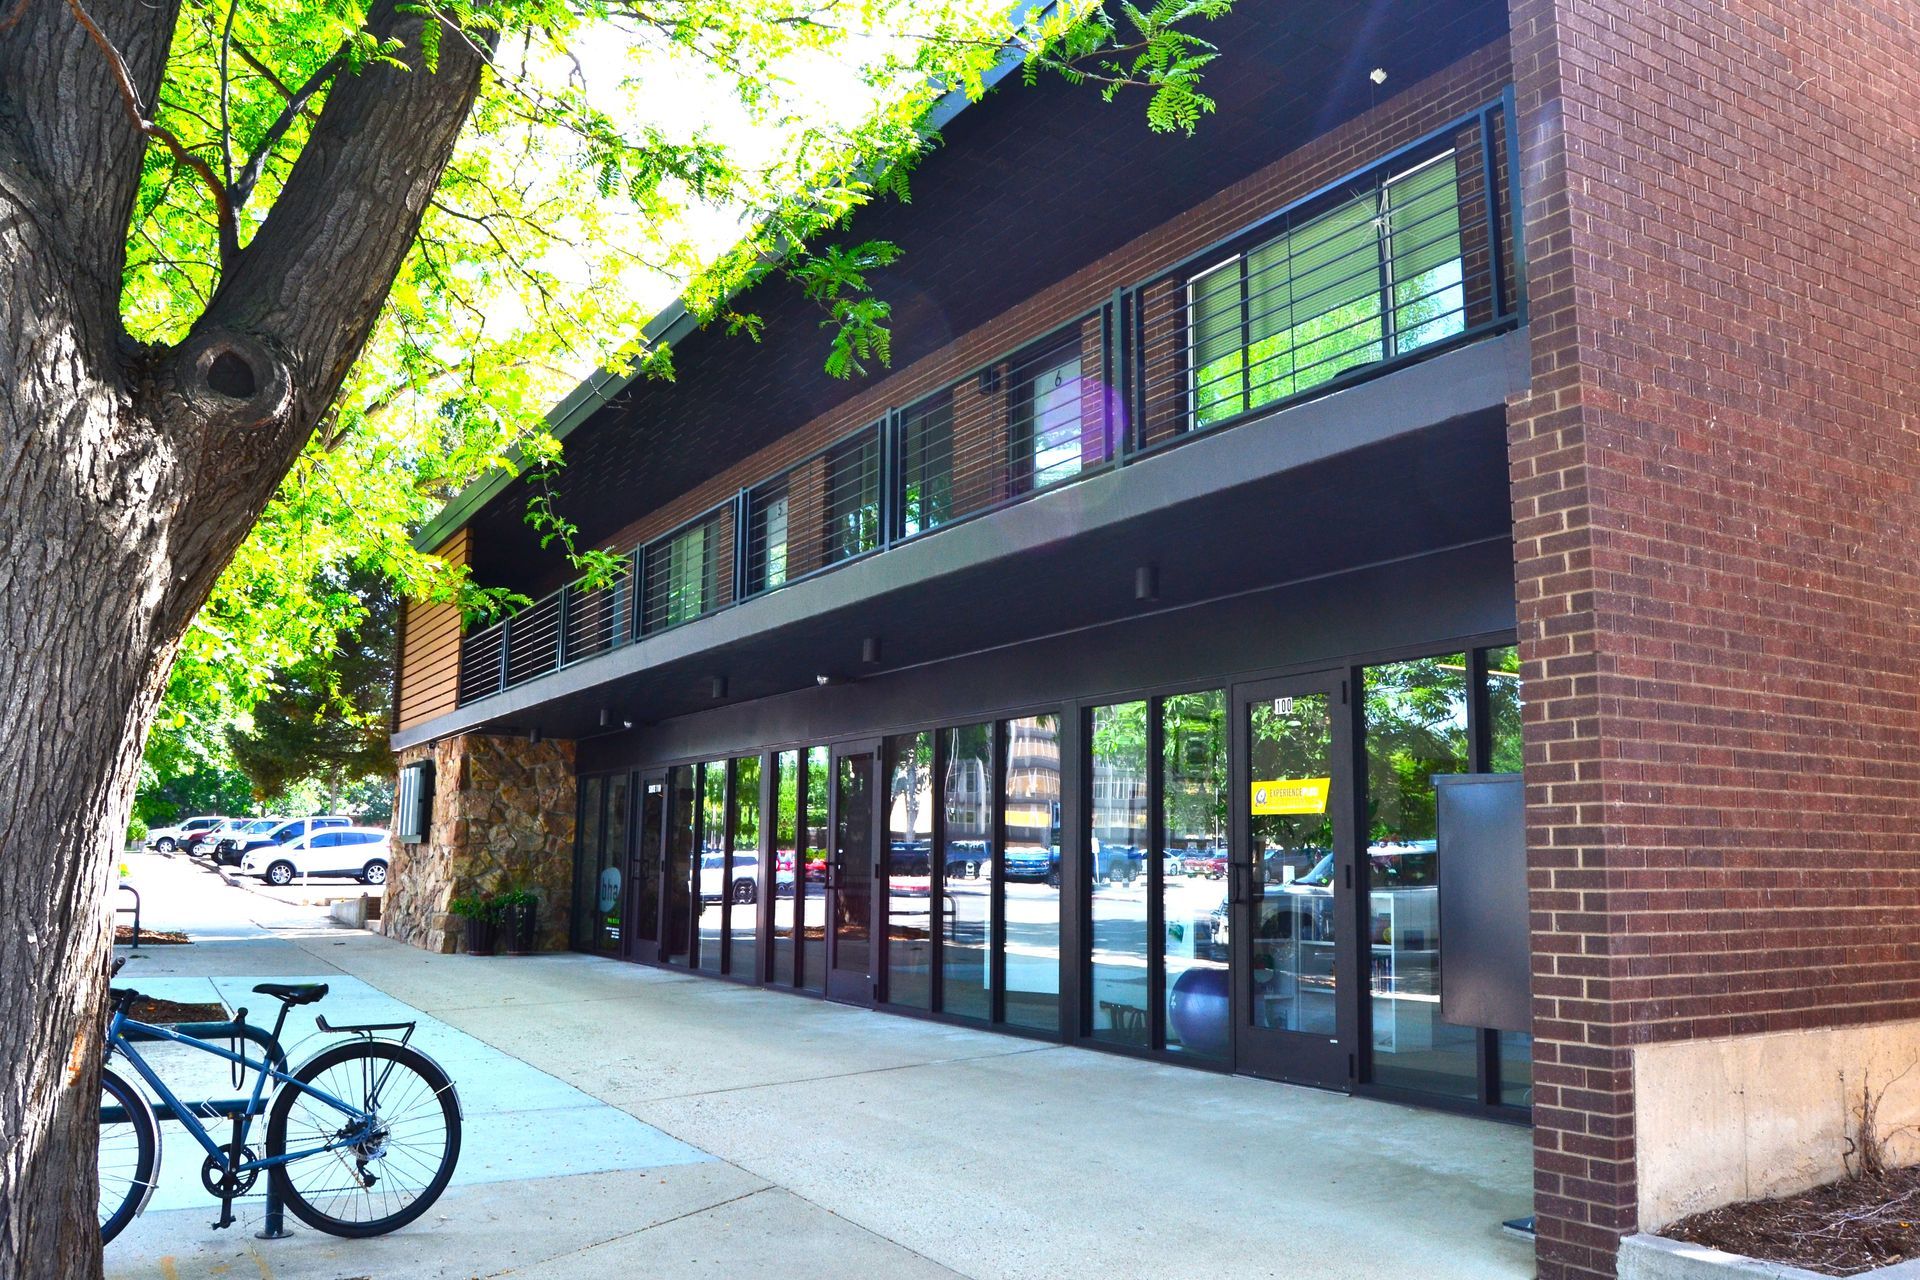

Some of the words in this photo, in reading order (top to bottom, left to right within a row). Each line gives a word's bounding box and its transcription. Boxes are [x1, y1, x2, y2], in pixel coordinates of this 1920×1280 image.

[1055, 370, 1061, 387] 6
[1276, 699, 1291, 713] 100
[602, 876, 618, 901] bha
